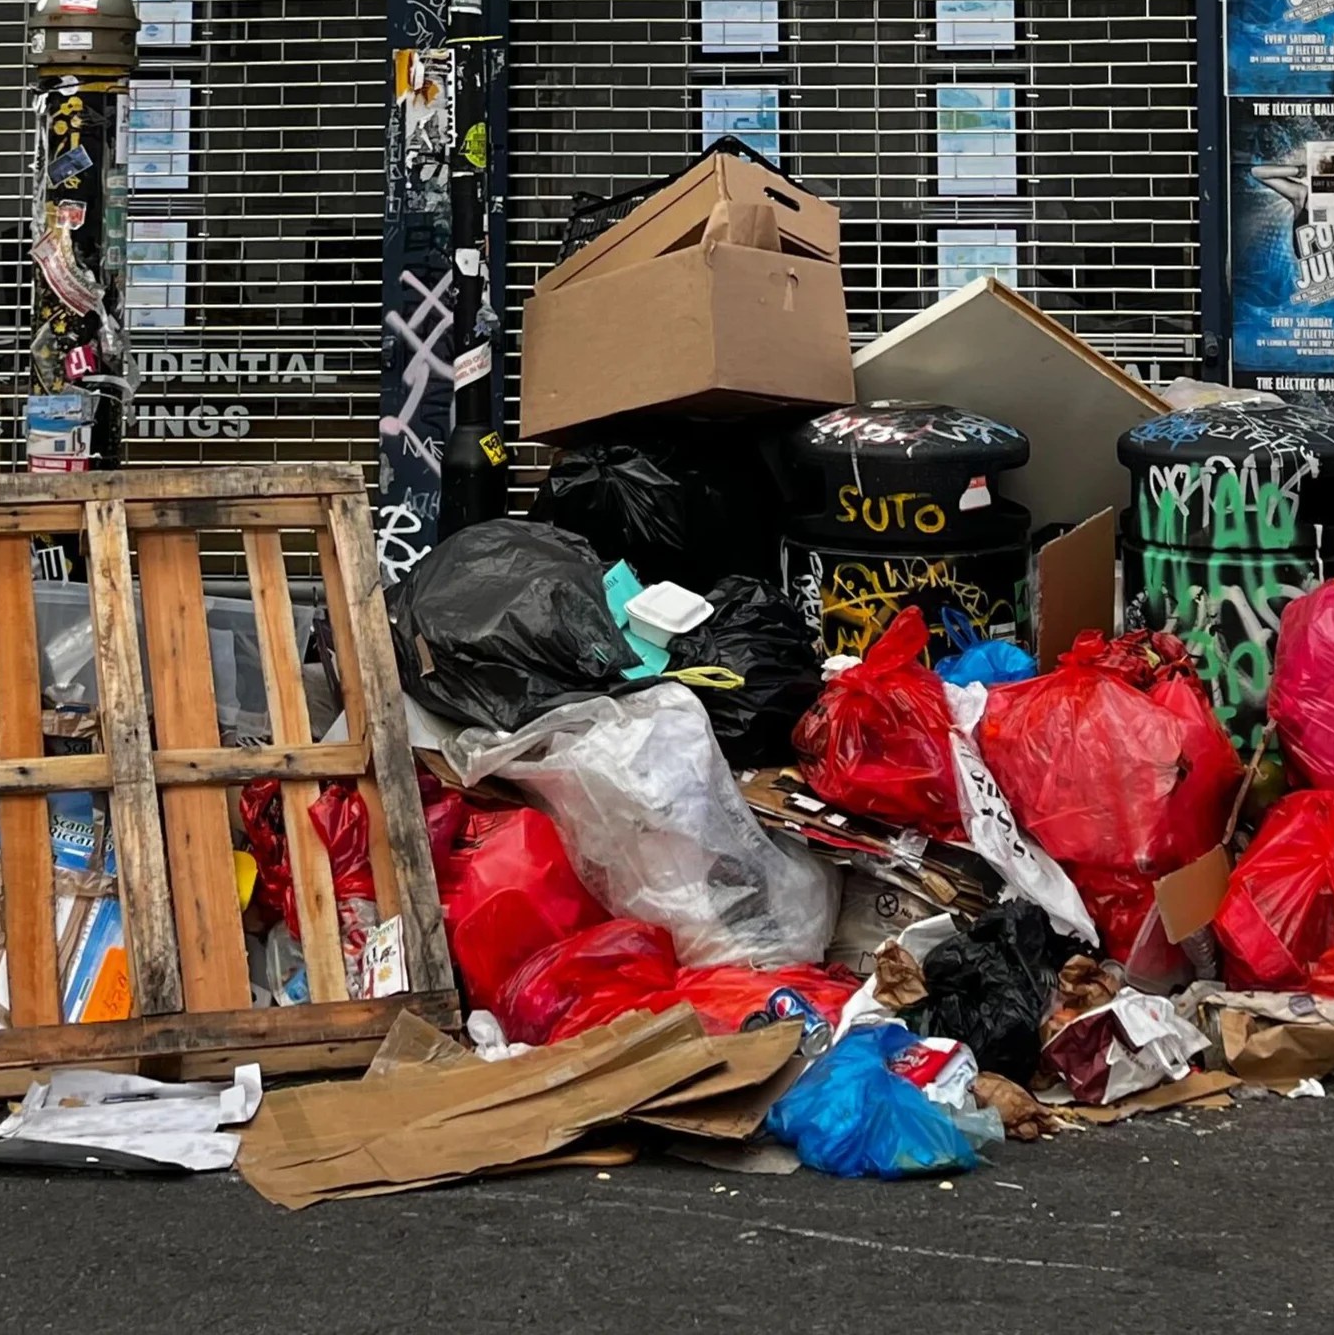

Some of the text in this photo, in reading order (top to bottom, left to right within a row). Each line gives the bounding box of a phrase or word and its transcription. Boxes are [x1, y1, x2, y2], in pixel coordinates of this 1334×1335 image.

[1253, 103, 1270, 116] THE
[1272, 102, 1312, 116] ELECTRIC
[1256, 377, 1273, 391] THE
[1275, 377, 1316, 391] ELECTRIC
[836, 484, 946, 534] SUTO
